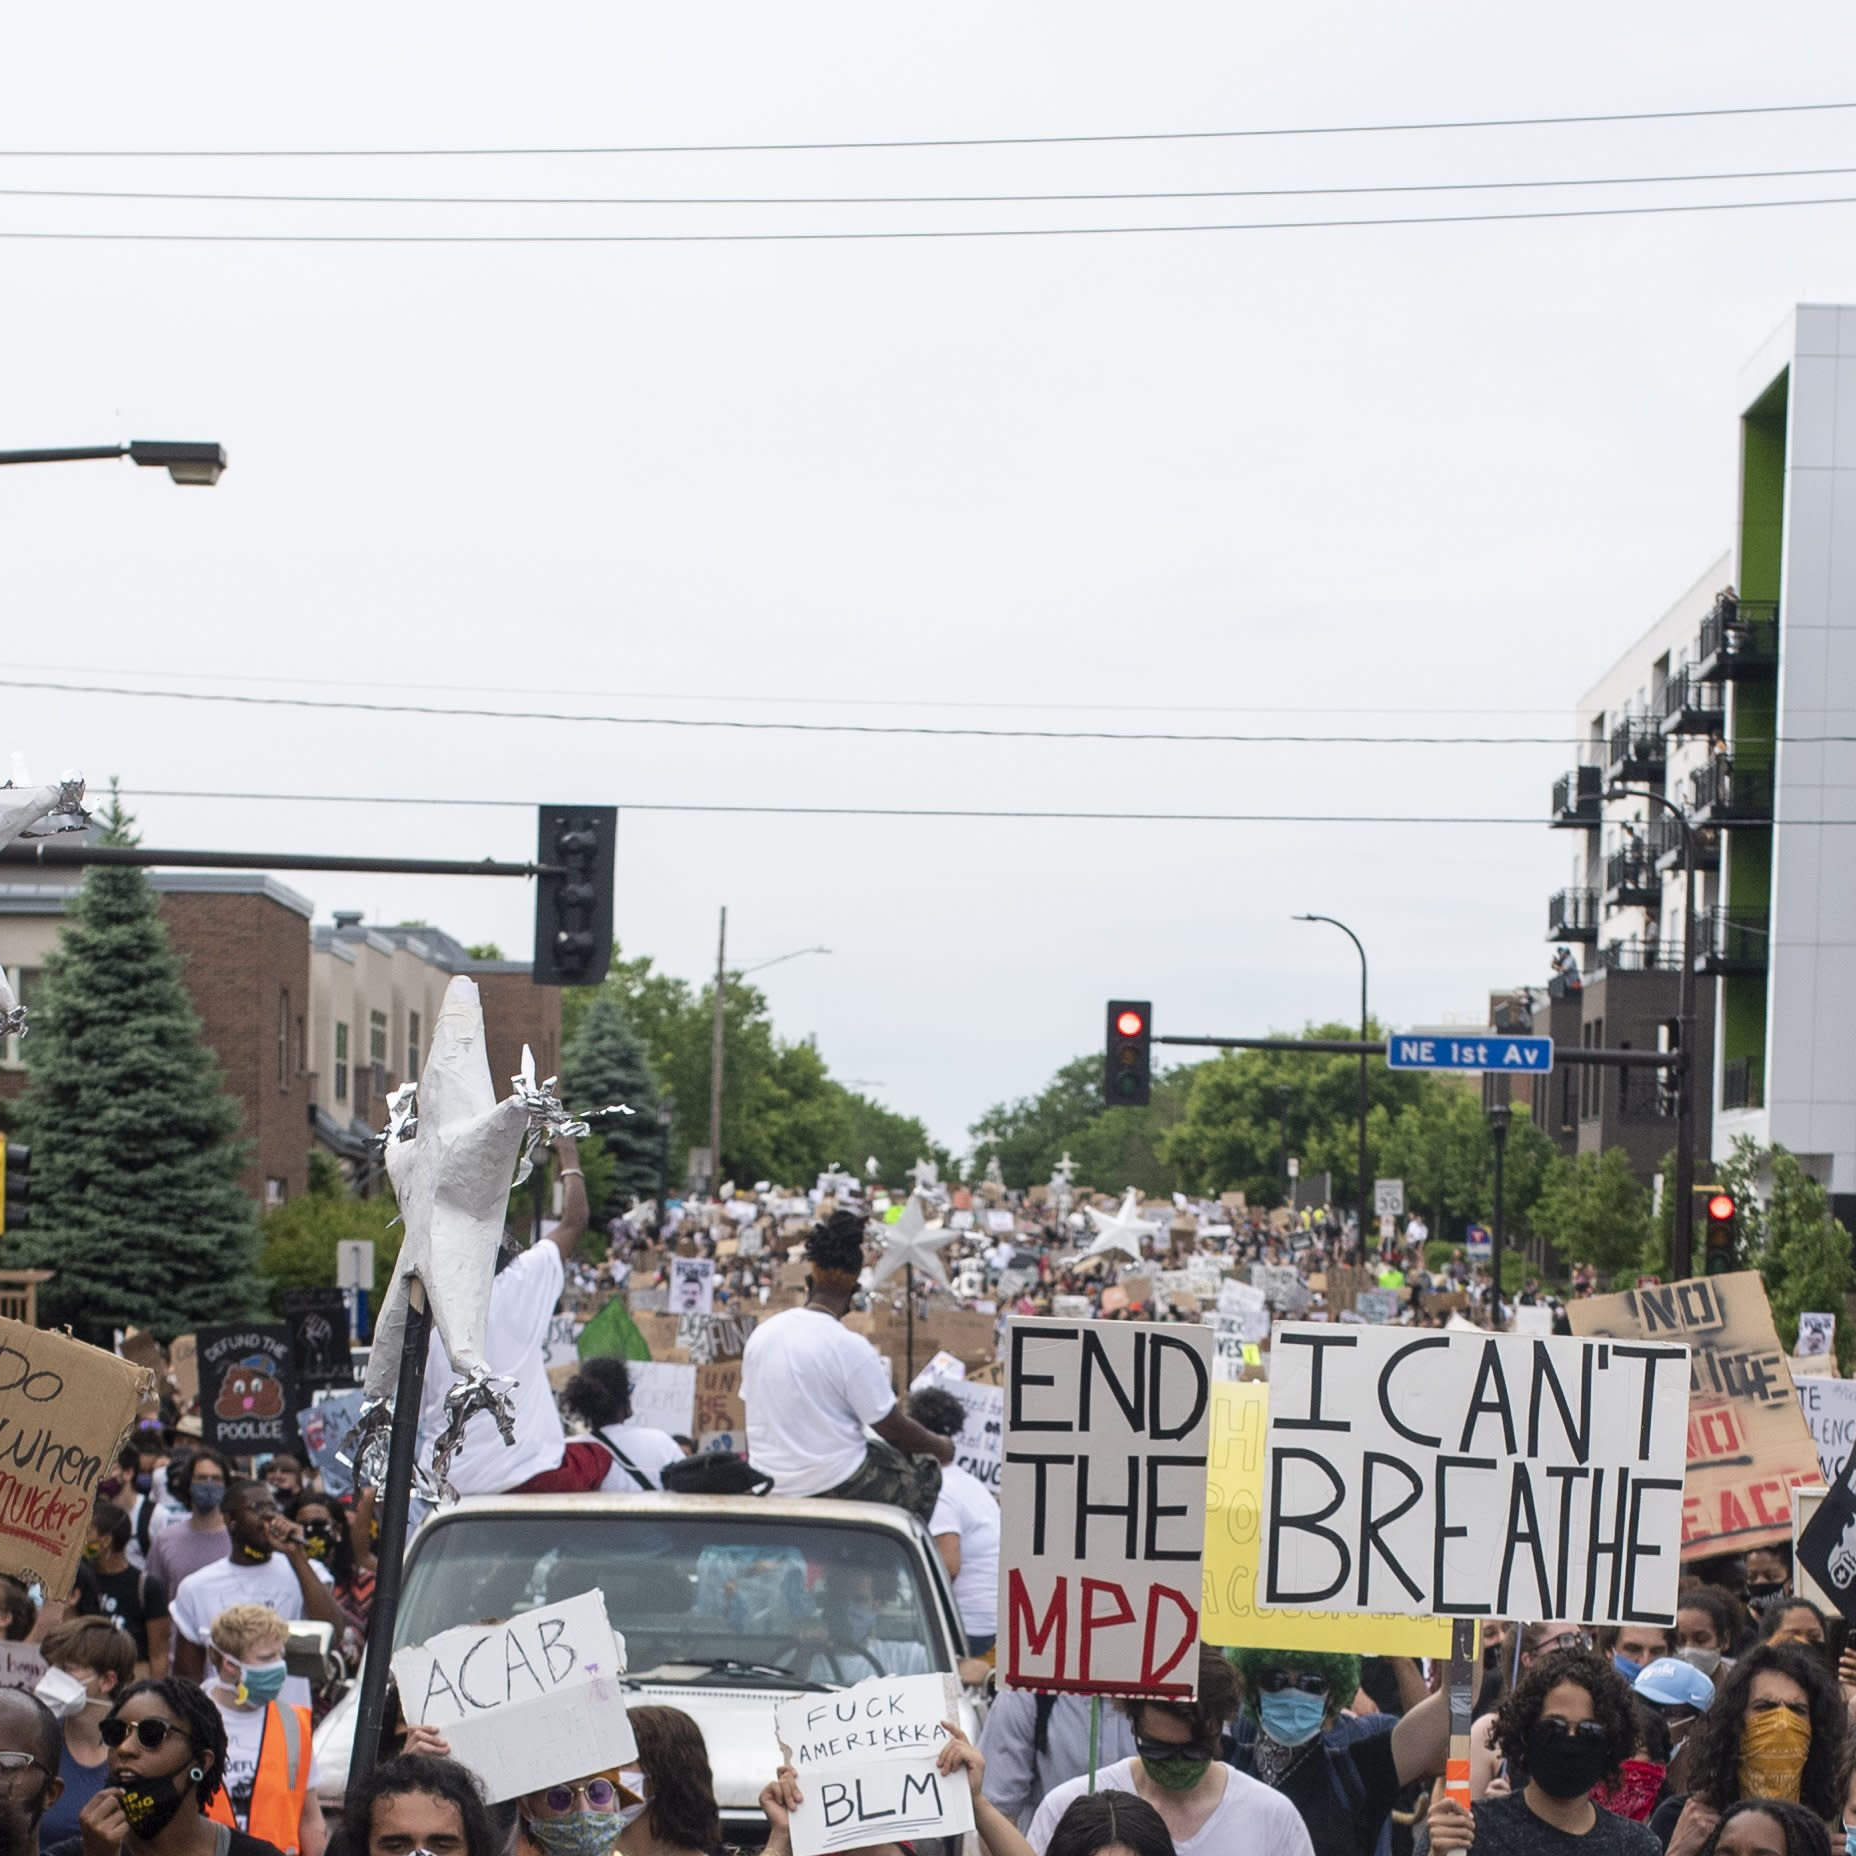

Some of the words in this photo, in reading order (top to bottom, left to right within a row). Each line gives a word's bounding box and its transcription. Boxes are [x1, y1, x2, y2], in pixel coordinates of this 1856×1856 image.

[1400, 1040, 1435, 1063] NE
[1450, 1041, 1488, 1065] 1st
[1501, 1043, 1539, 1066] Av
[1638, 1280, 1717, 1332] NO
[203, 1332, 261, 1363] DEFUND
[261, 1335, 288, 1360] THE
[1009, 1326, 1209, 1442] END
[1272, 1332, 1358, 1433] I
[1377, 1334, 1687, 1466] CAN'T
[216, 1419, 283, 1441] POOLICE
[1005, 1450, 1207, 1562] THE
[1265, 1446, 1684, 1626] BREATHE
[1008, 1568, 1199, 1690] MPD
[421, 1618, 578, 1727] ACAB
[805, 1691, 906, 1734] FUCK
[799, 1721, 946, 1764] AMERIKKKA
[819, 1773, 944, 1829] BLM
